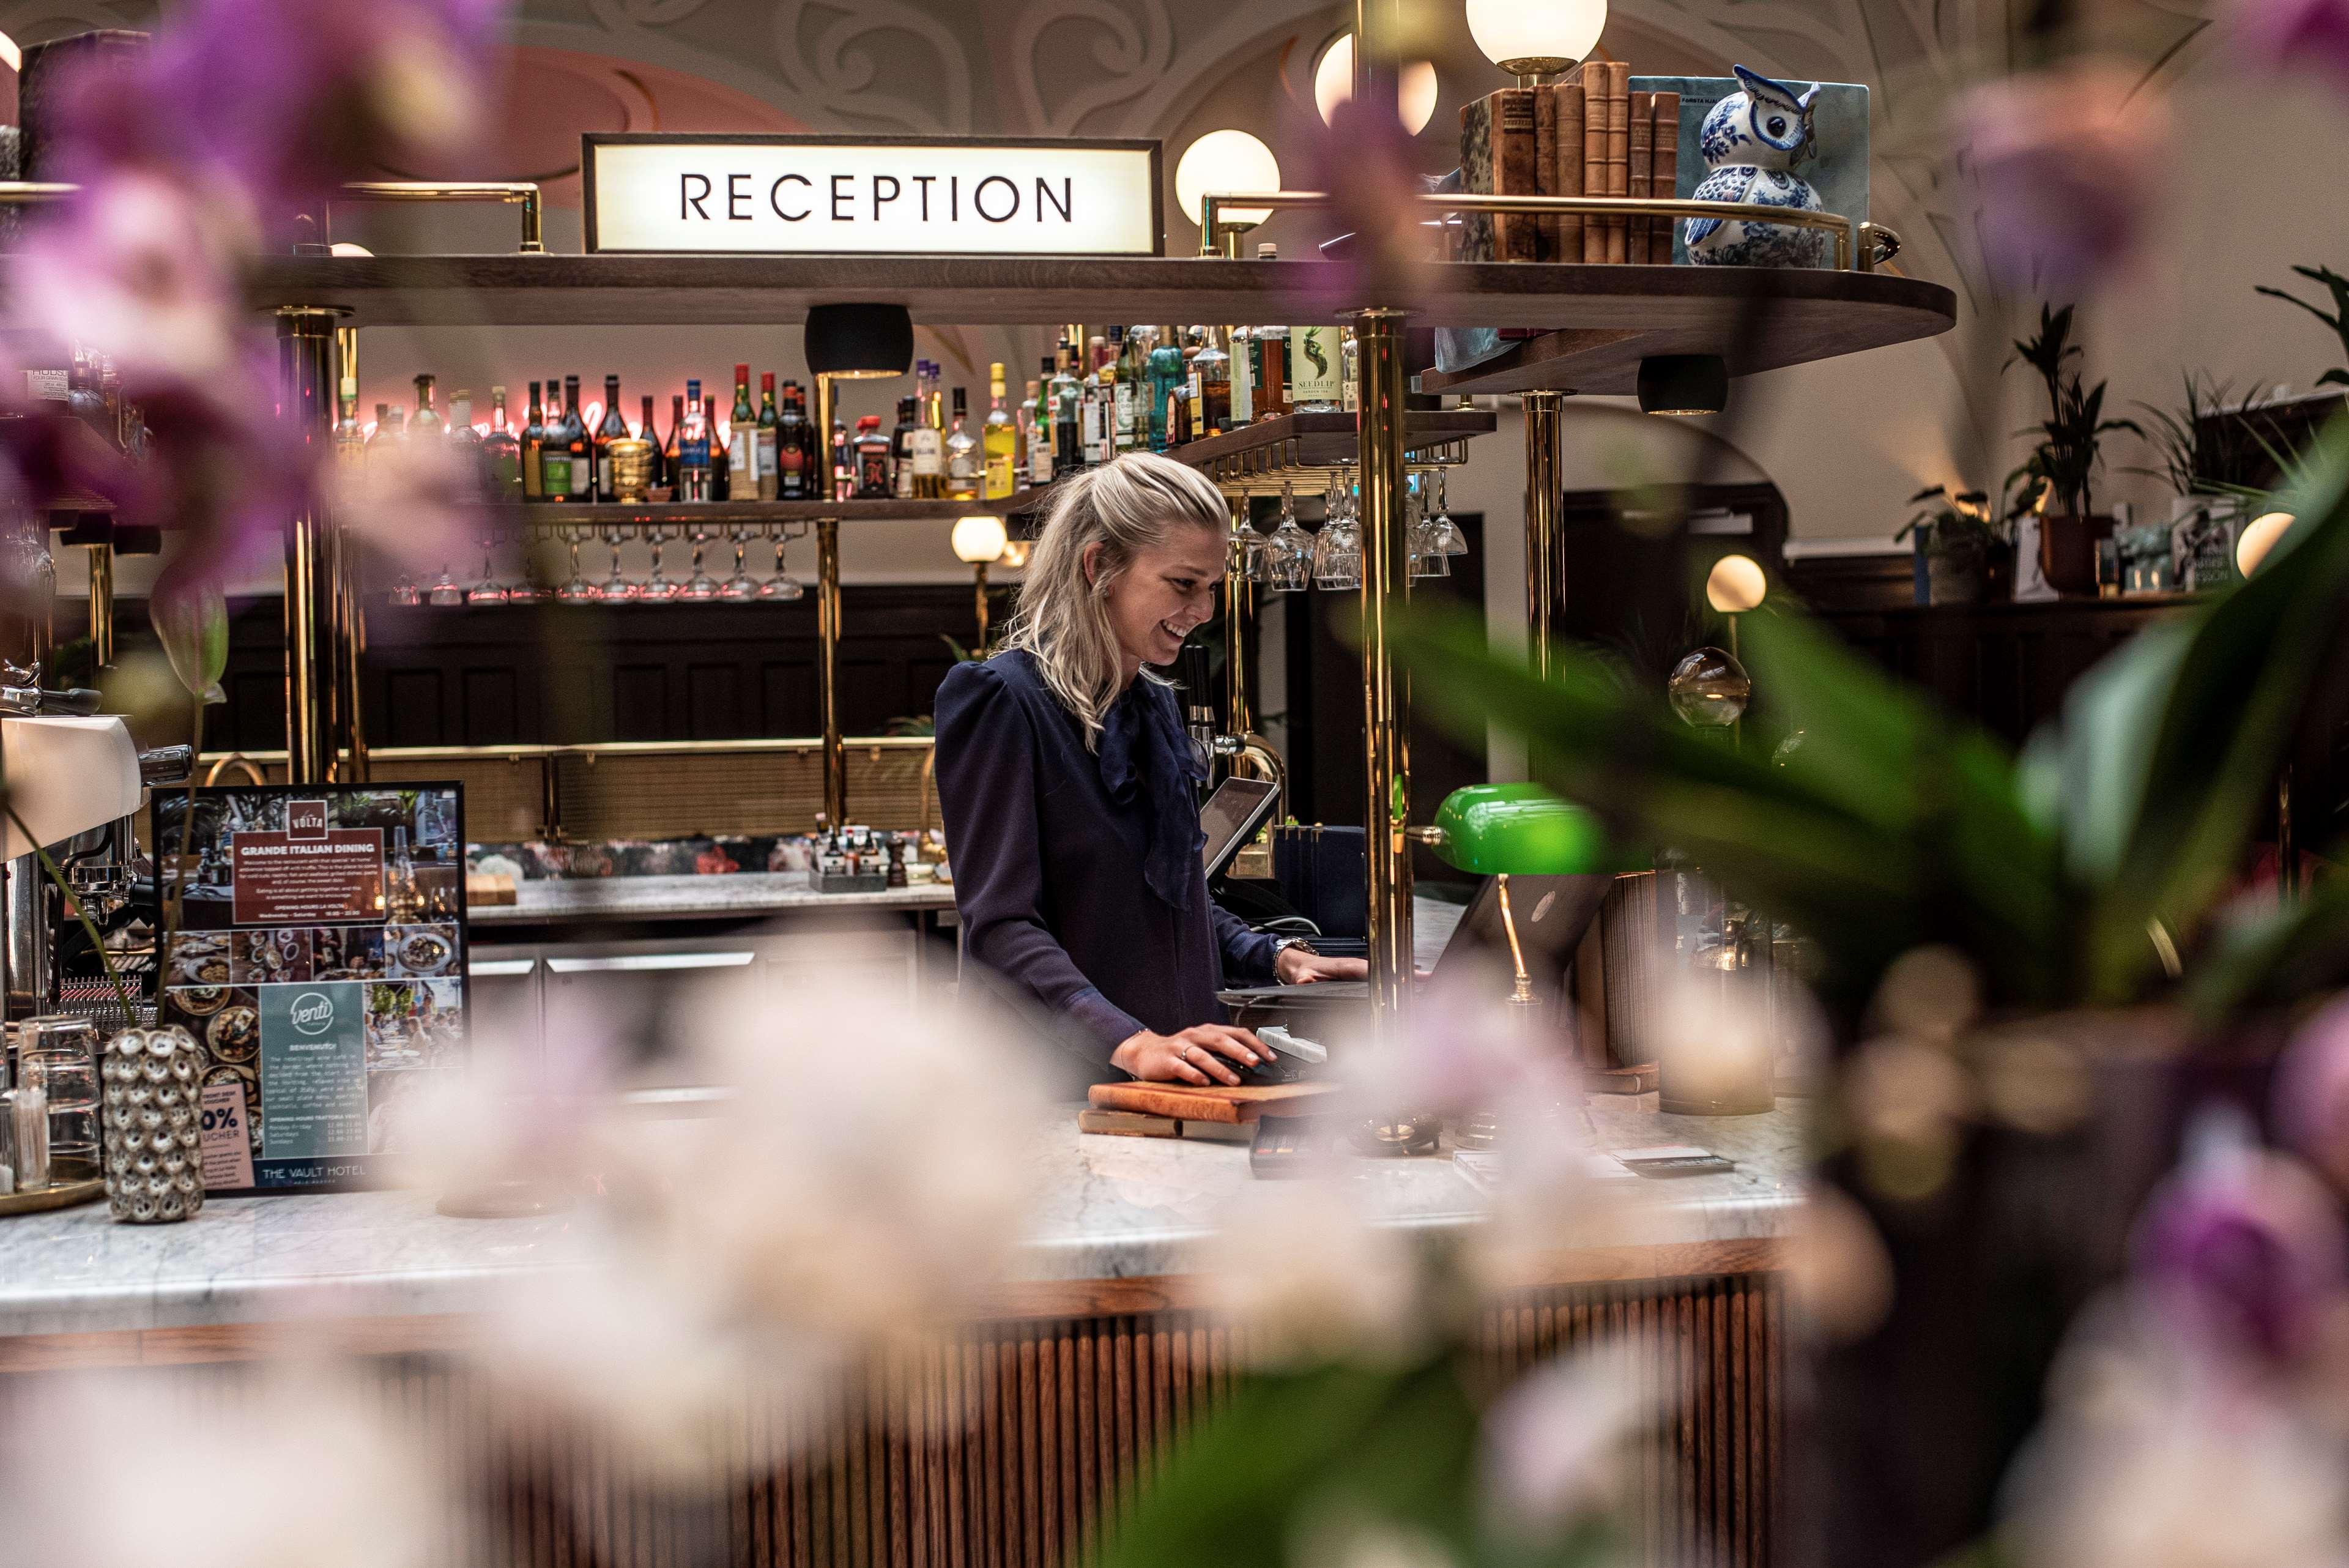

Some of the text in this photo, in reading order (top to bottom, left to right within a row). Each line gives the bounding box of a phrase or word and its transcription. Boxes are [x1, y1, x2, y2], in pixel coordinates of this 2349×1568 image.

[681, 174, 1071, 222] RECEPTION
[1298, 381, 1334, 390] SEEDLIP
[292, 817, 324, 829] VOLTA
[240, 843, 374, 856] GRANDE ITALIAN DINING
[291, 1001, 329, 1025] venti
[201, 1107, 238, 1131] 0%
[202, 1130, 240, 1142] UCHER
[262, 1165, 367, 1179] THE VAULT HOTEL
